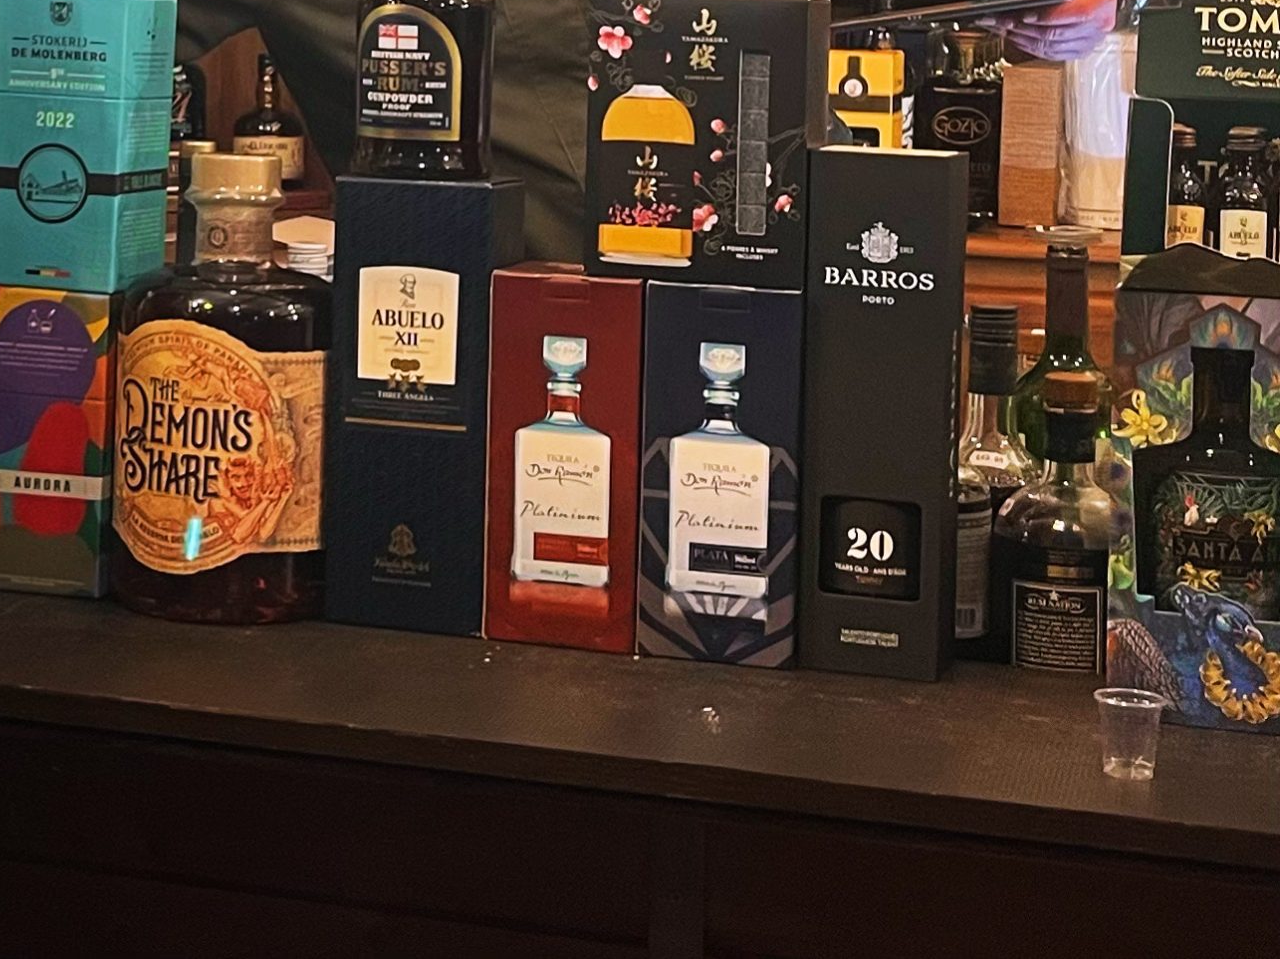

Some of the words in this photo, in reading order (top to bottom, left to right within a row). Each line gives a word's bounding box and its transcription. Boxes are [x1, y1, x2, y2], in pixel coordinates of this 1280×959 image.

[31, 34, 88, 49] STOKERIJ
[1201, 36, 1273, 49] HIGHLAND
[10, 47, 28, 59] DE
[30, 48, 108, 63] MOLENBERG
[405, 51, 432, 61] NAVY
[1226, 47, 1280, 60] SCOTCH
[361, 57, 448, 78] PUSSER'S
[376, 75, 420, 92] RUM
[366, 90, 435, 106] GUNPOWDER
[381, 102, 413, 112] PROOF
[35, 110, 76, 129] 2022
[824, 266, 936, 292] BARROS
[862, 294, 896, 306] PORTO
[371, 308, 445, 331] ABUELO
[394, 331, 419, 347] XII
[158, 336, 193, 347] SPIRIT
[195, 340, 209, 350] OF
[213, 346, 255, 379] PANAMA
[150, 376, 181, 402] THE
[377, 390, 401, 400] THREE
[404, 392, 435, 402] ANGELS
[123, 378, 253, 454] DEMON'S
[120, 437, 221, 505] SHARE
[524, 463, 552, 478] Don
[13, 475, 72, 493] AURORA
[679, 472, 708, 487] Don
[519, 500, 601, 522] Platinium
[674, 509, 759, 532] Platinium
[846, 526, 895, 562] 20
[1174, 538, 1243, 563] SANTA
[693, 547, 729, 561] PLATA
[834, 561, 854, 574] YEARS
[854, 564, 870, 575] OLD
